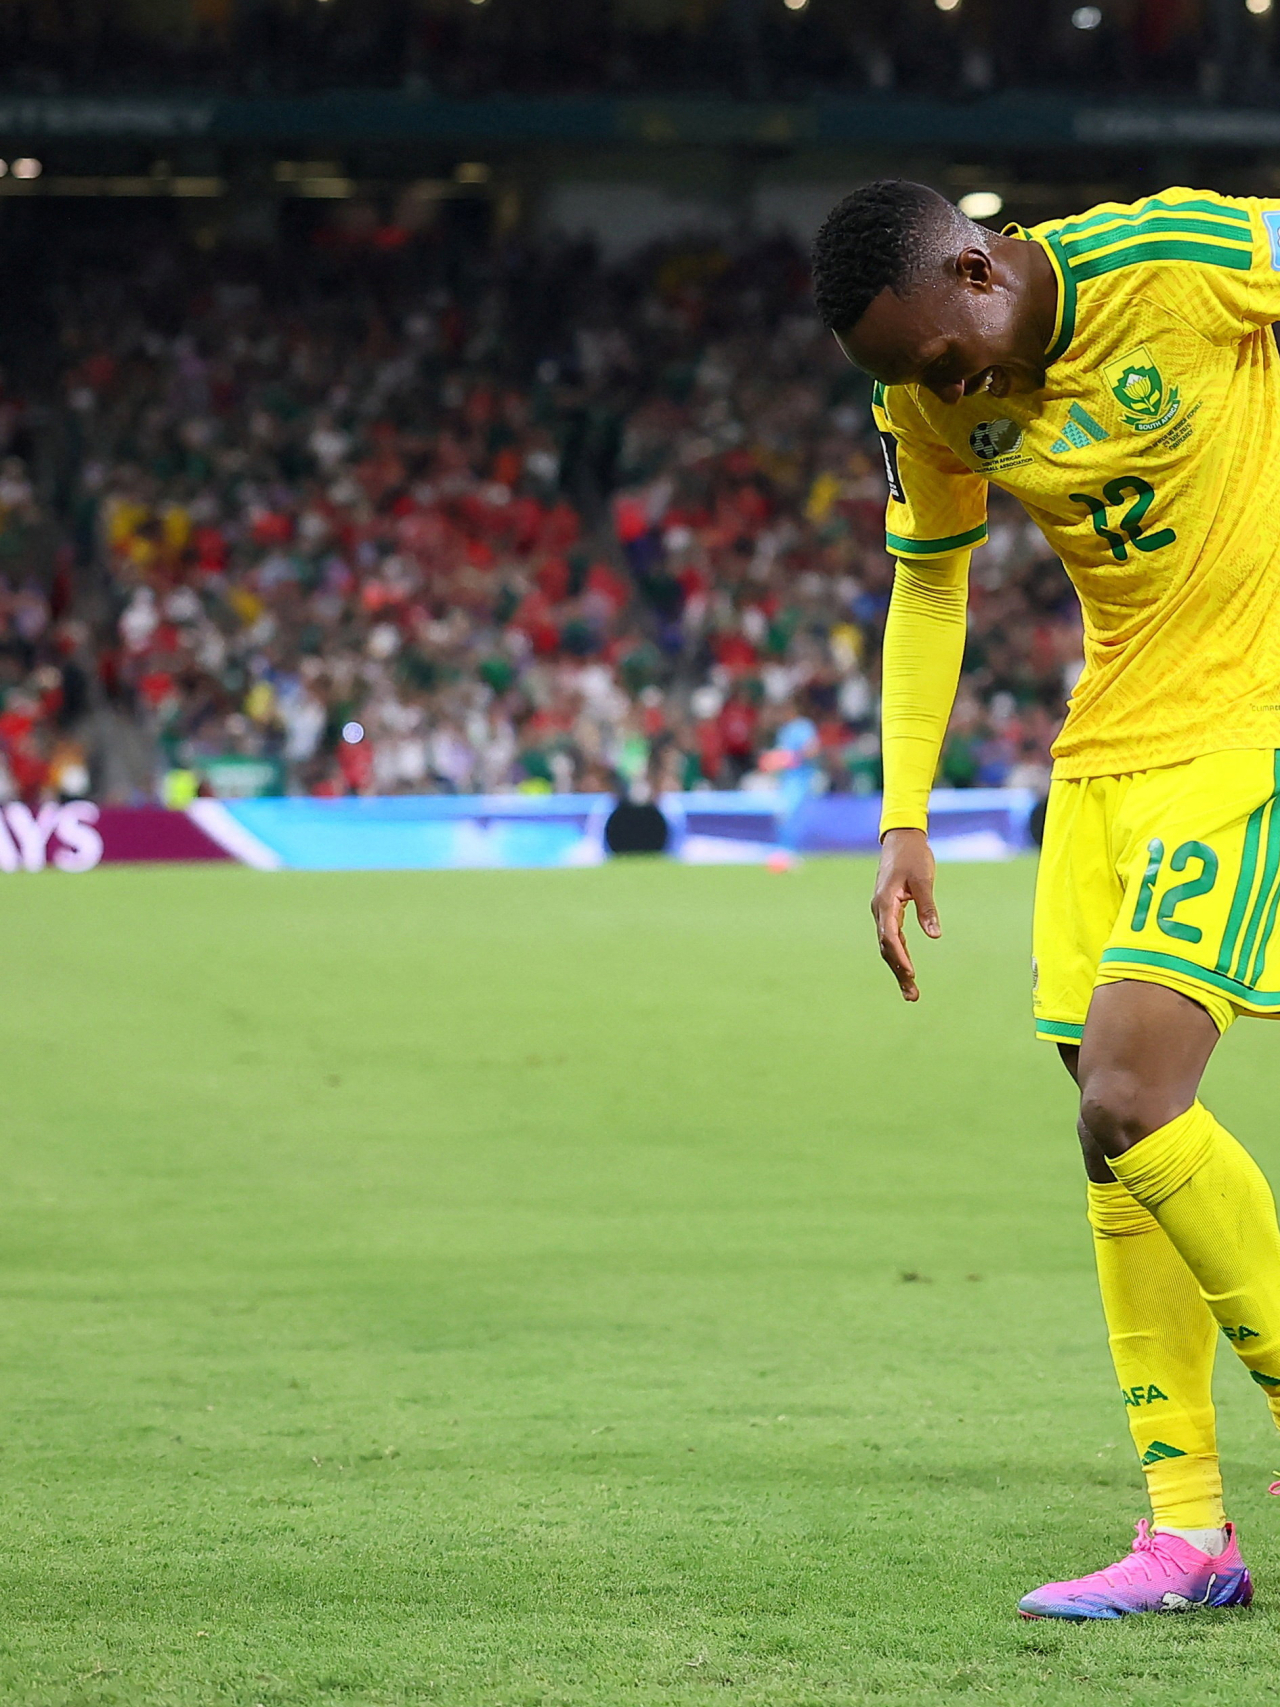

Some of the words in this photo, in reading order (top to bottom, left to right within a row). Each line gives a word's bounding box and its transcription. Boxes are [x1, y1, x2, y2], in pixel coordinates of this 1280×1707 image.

[1138, 420, 1162, 431] SOUTH
[1161, 403, 1179, 424] AFRICA
[1000, 454, 1022, 463] AFRICAN
[1000, 457, 1034, 469] ASSOCIATION
[1069, 476, 1176, 561] 12
[1131, 838, 1218, 944] 12
